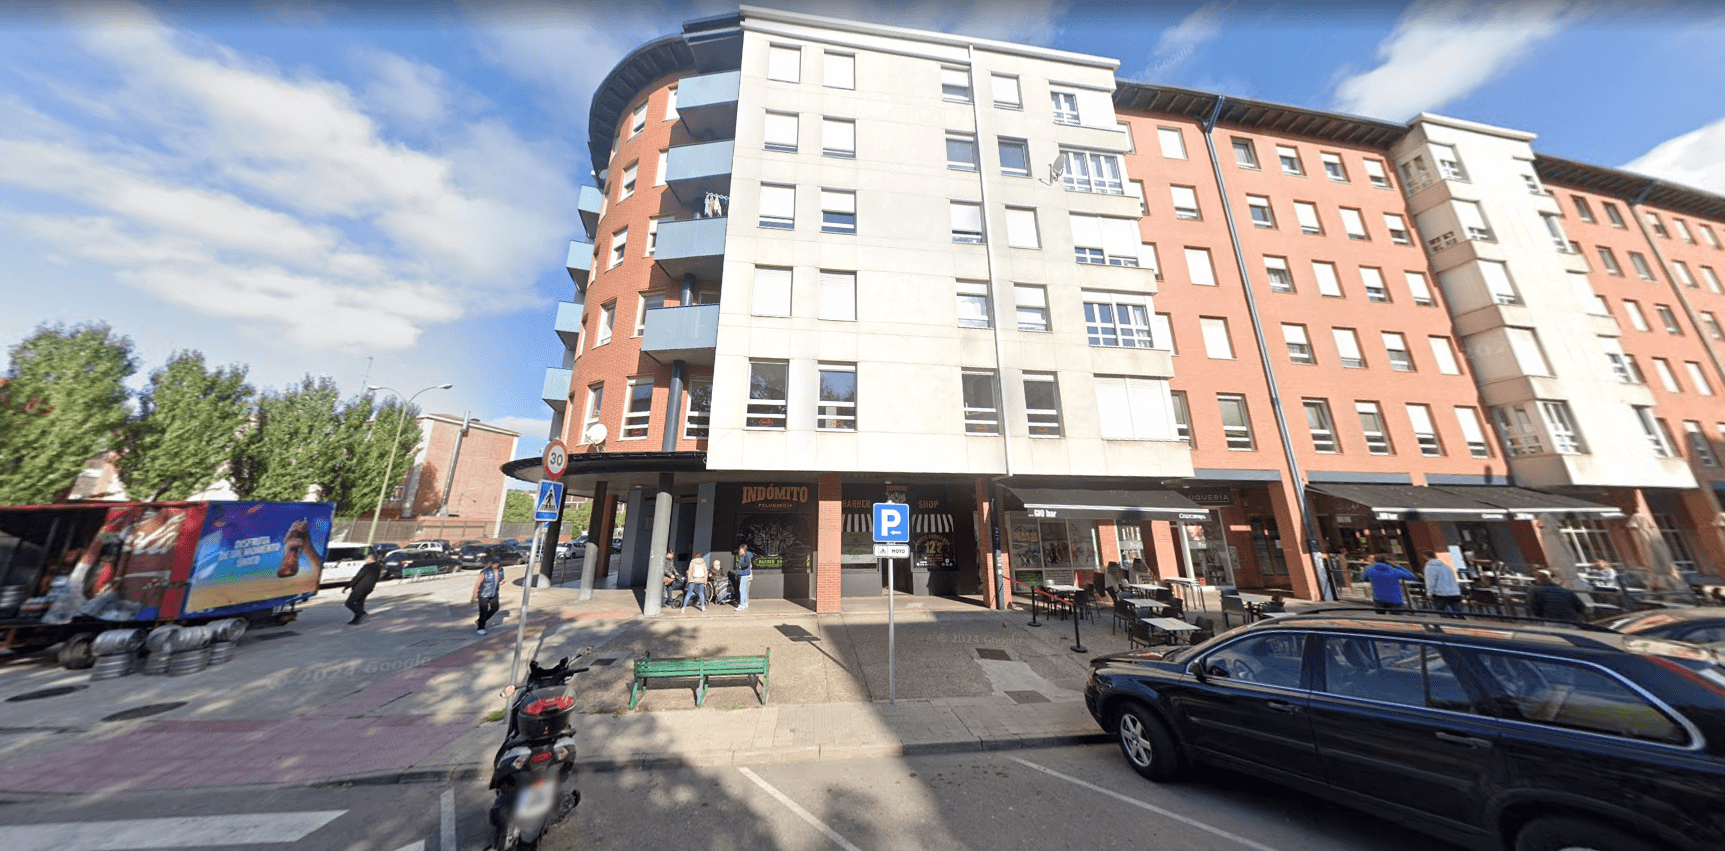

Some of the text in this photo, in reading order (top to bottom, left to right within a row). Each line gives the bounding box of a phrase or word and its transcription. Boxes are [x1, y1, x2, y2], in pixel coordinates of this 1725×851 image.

[550, 452, 563, 467] 30
[741, 484, 809, 504] INDÓMITO
[842, 500, 940, 509] BARBER SHOP
[881, 508, 902, 537] P
